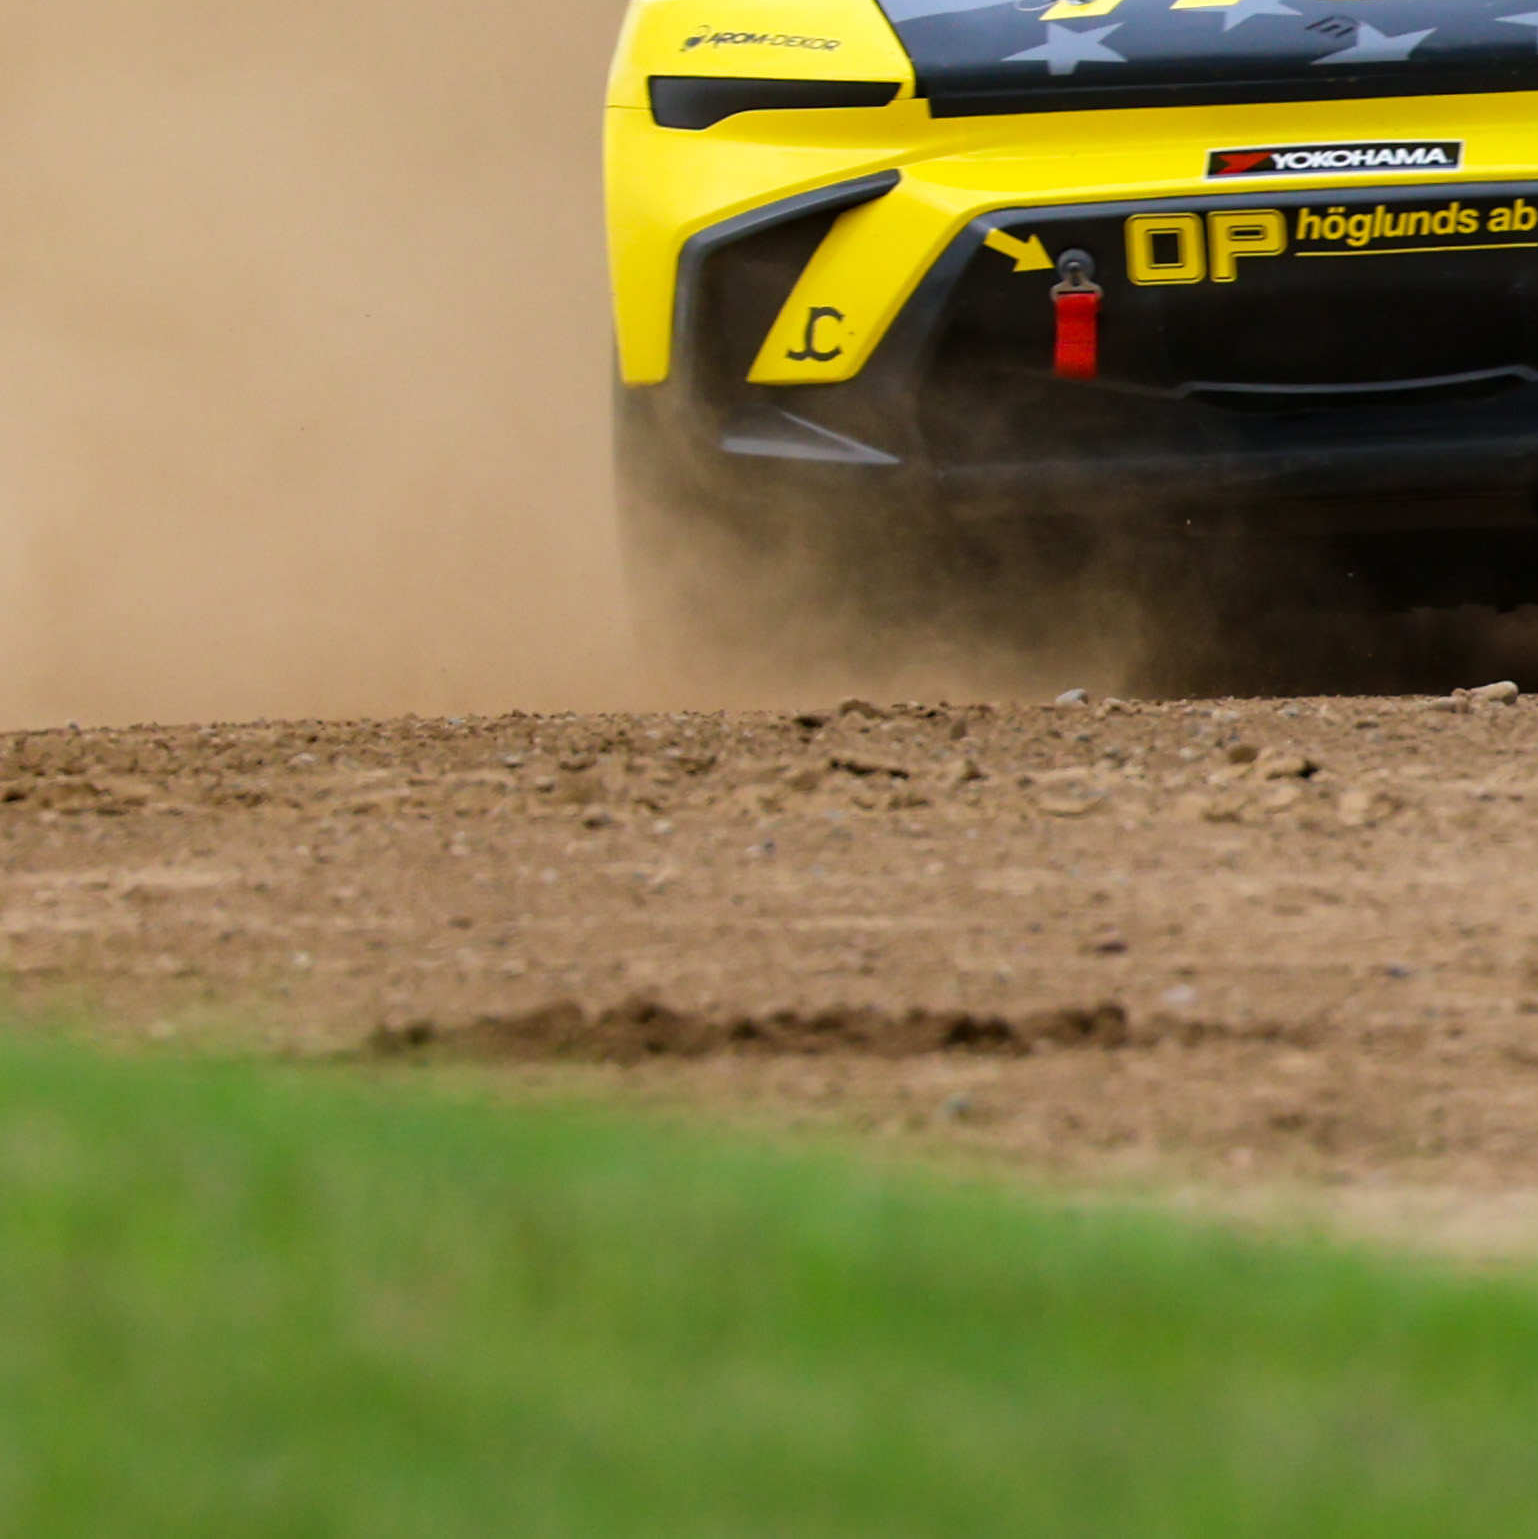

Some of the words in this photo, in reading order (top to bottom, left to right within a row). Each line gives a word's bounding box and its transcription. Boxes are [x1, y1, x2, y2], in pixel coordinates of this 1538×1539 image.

[1271, 147, 1450, 170] YOKOHAMA
[1124, 209, 1288, 286] OP
[1295, 202, 1480, 247] höglunds
[1486, 198, 1538, 232] ab
